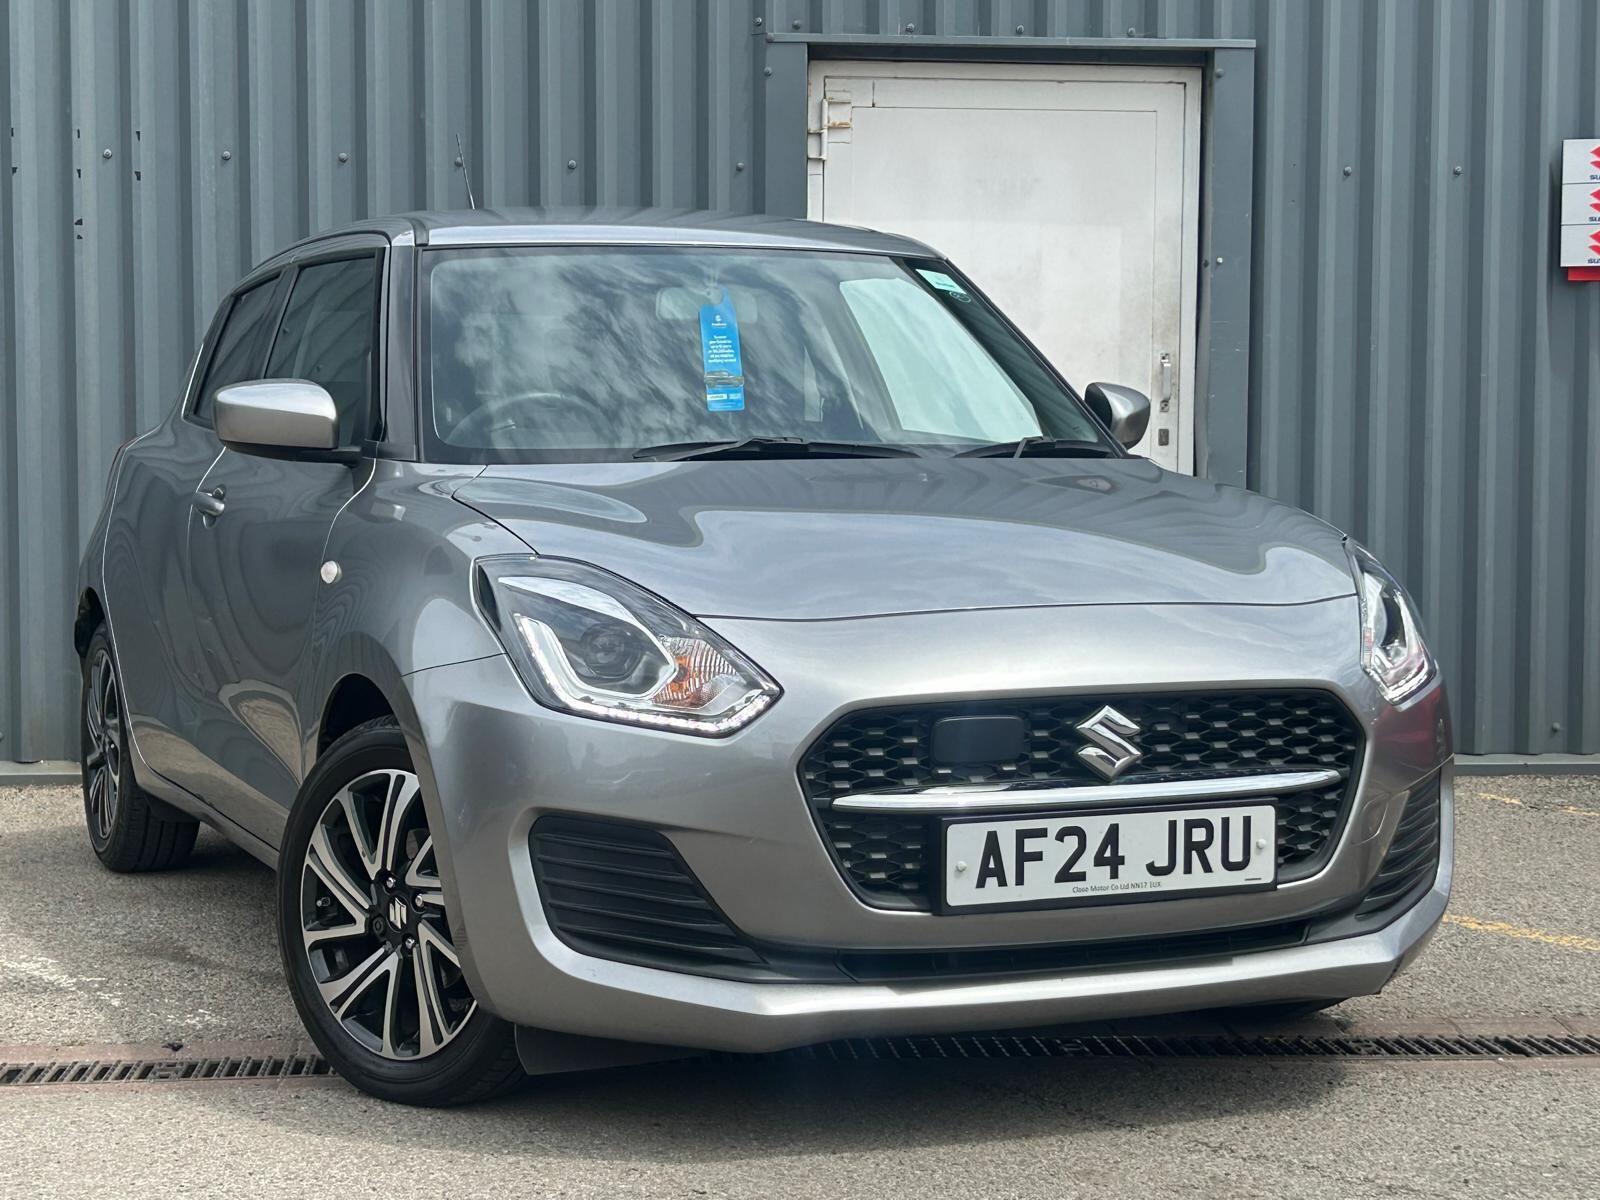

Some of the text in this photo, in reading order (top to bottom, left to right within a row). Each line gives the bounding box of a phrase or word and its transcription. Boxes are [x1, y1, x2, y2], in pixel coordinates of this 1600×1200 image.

[975, 815, 1252, 889] AF24 JRU
[1130, 881, 1147, 889] NN17
